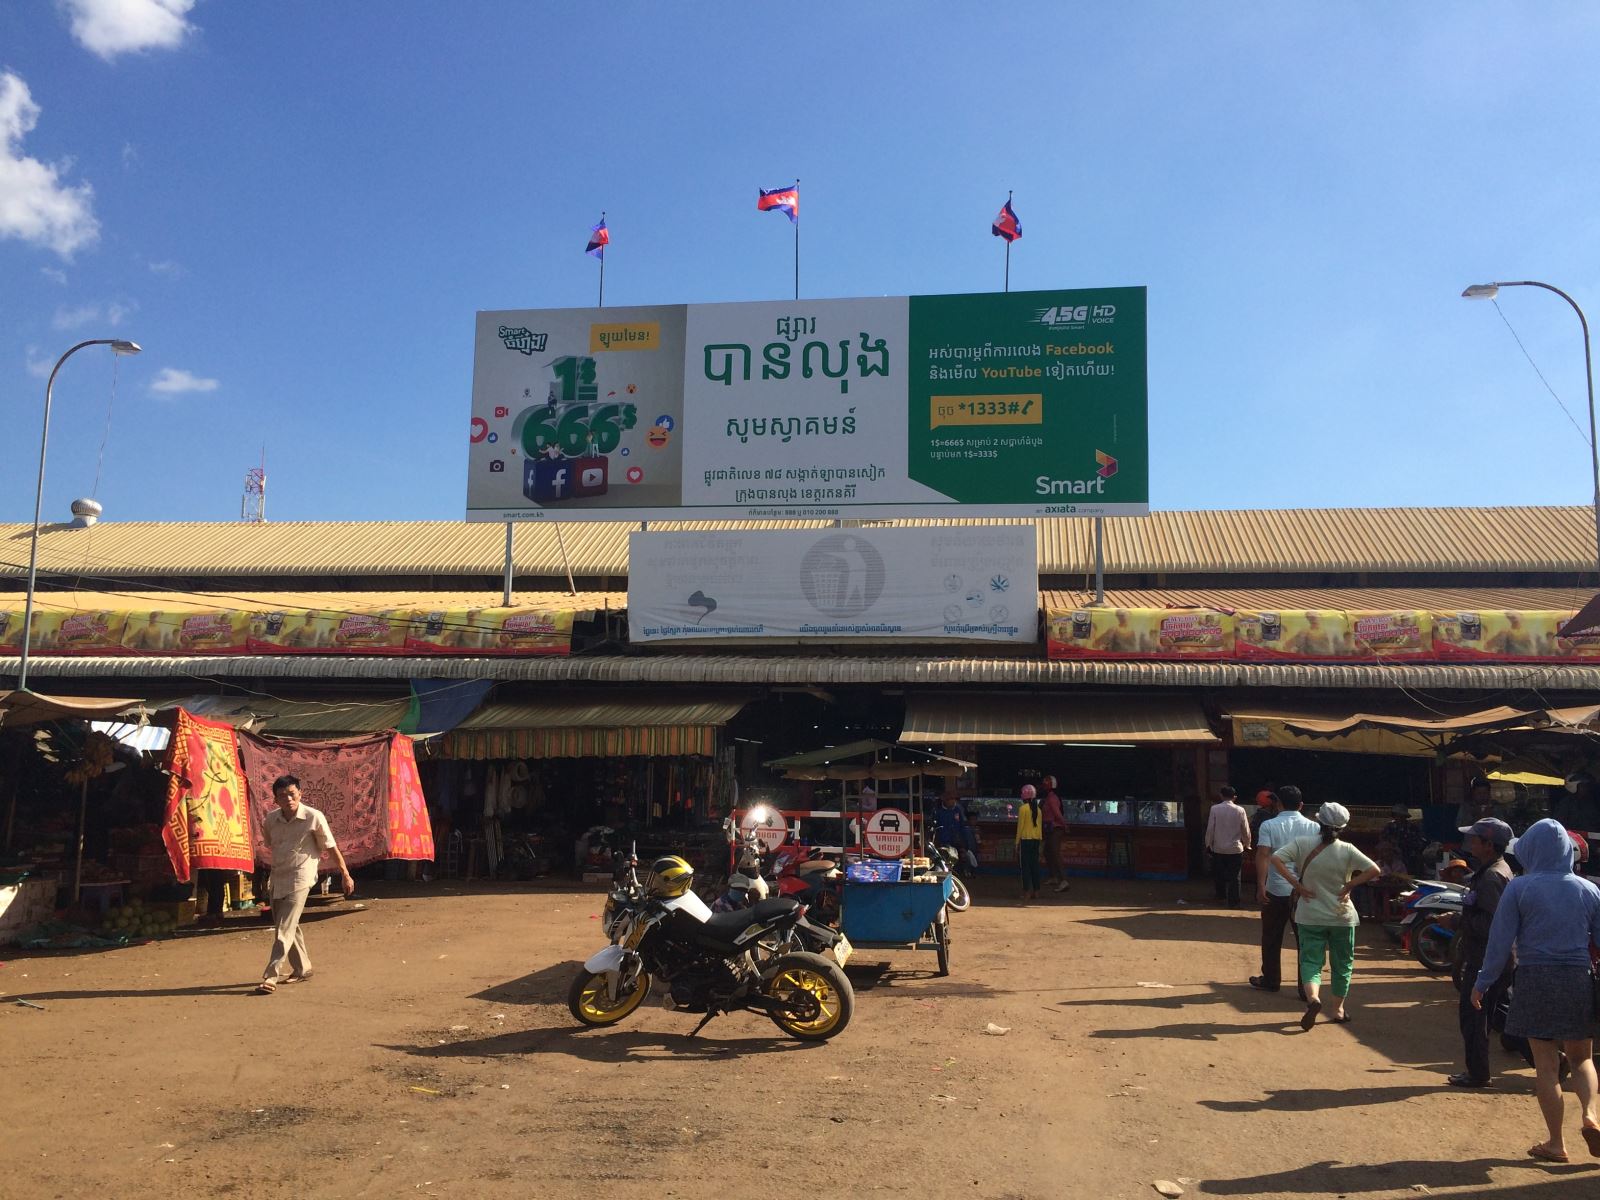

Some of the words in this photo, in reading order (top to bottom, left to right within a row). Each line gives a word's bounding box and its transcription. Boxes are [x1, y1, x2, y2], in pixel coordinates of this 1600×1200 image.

[1092, 305, 1116, 317] HD
[499, 326, 525, 337] Smart
[776, 316, 816, 341] ផ្សារ
[1046, 342, 1114, 355] Facebook
[704, 333, 889, 393] បានលុង
[982, 365, 1041, 379] YouTube
[726, 407, 856, 443] សូមស្វាគមន៍
[930, 438, 964, 447] 1$=666$
[993, 438, 998, 446] 2
[964, 450, 998, 458] 1$=333$
[1036, 475, 1106, 495] Smart
[1044, 504, 1077, 513] axiata
